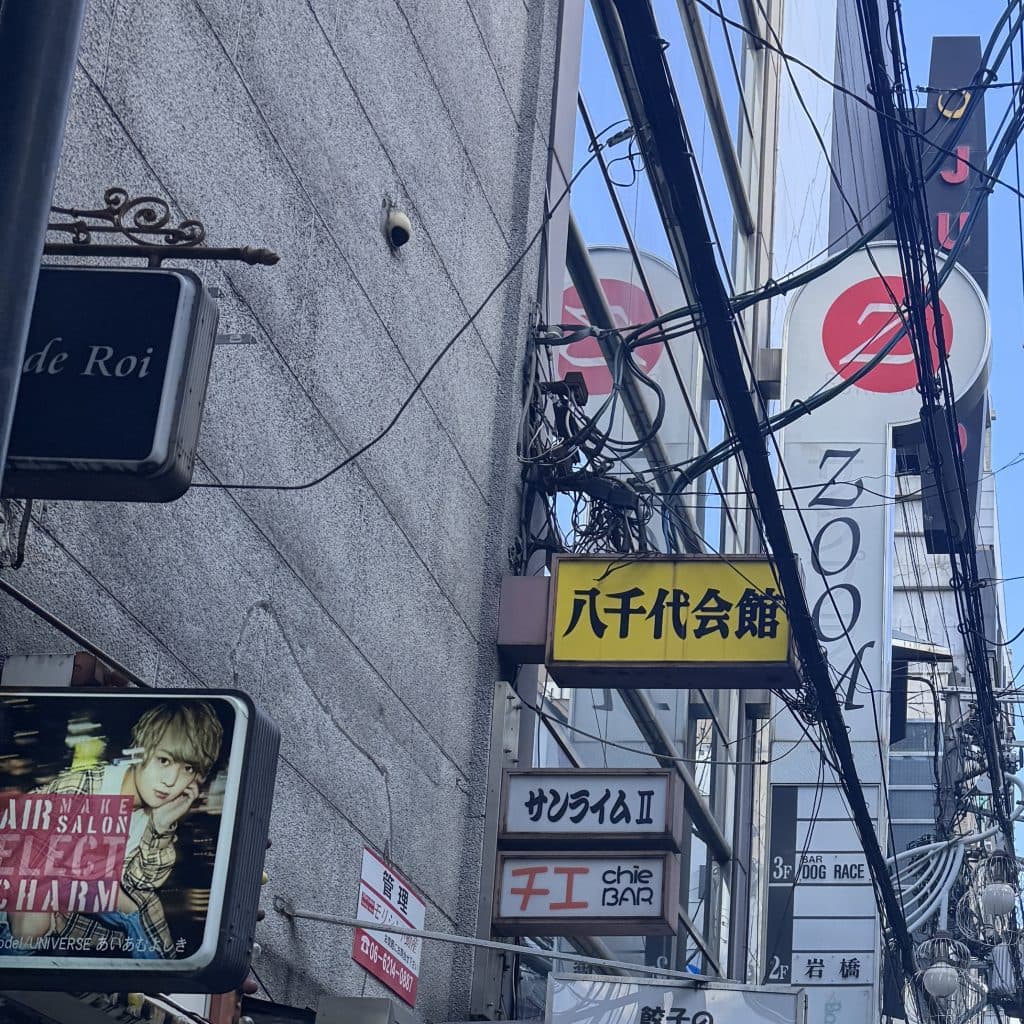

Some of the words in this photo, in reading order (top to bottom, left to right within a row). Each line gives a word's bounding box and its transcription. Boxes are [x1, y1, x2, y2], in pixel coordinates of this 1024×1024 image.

[22, 337, 67, 374] de
[80, 344, 153, 379] Roi
[562, 587, 785, 640] 八千代会館
[60, 798, 130, 814] MAKE
[56, 815, 129, 834] SALON
[773, 856, 793, 882] 3F
[801, 863, 827, 880] DOG
[833, 863, 865, 879] RACE
[802, 856, 823, 864] BAR
[382, 870, 409, 916] 管理
[602, 886, 654, 907] BAR
[768, 958, 790, 981] 2F
[804, 957, 862, 980] 岩橋
